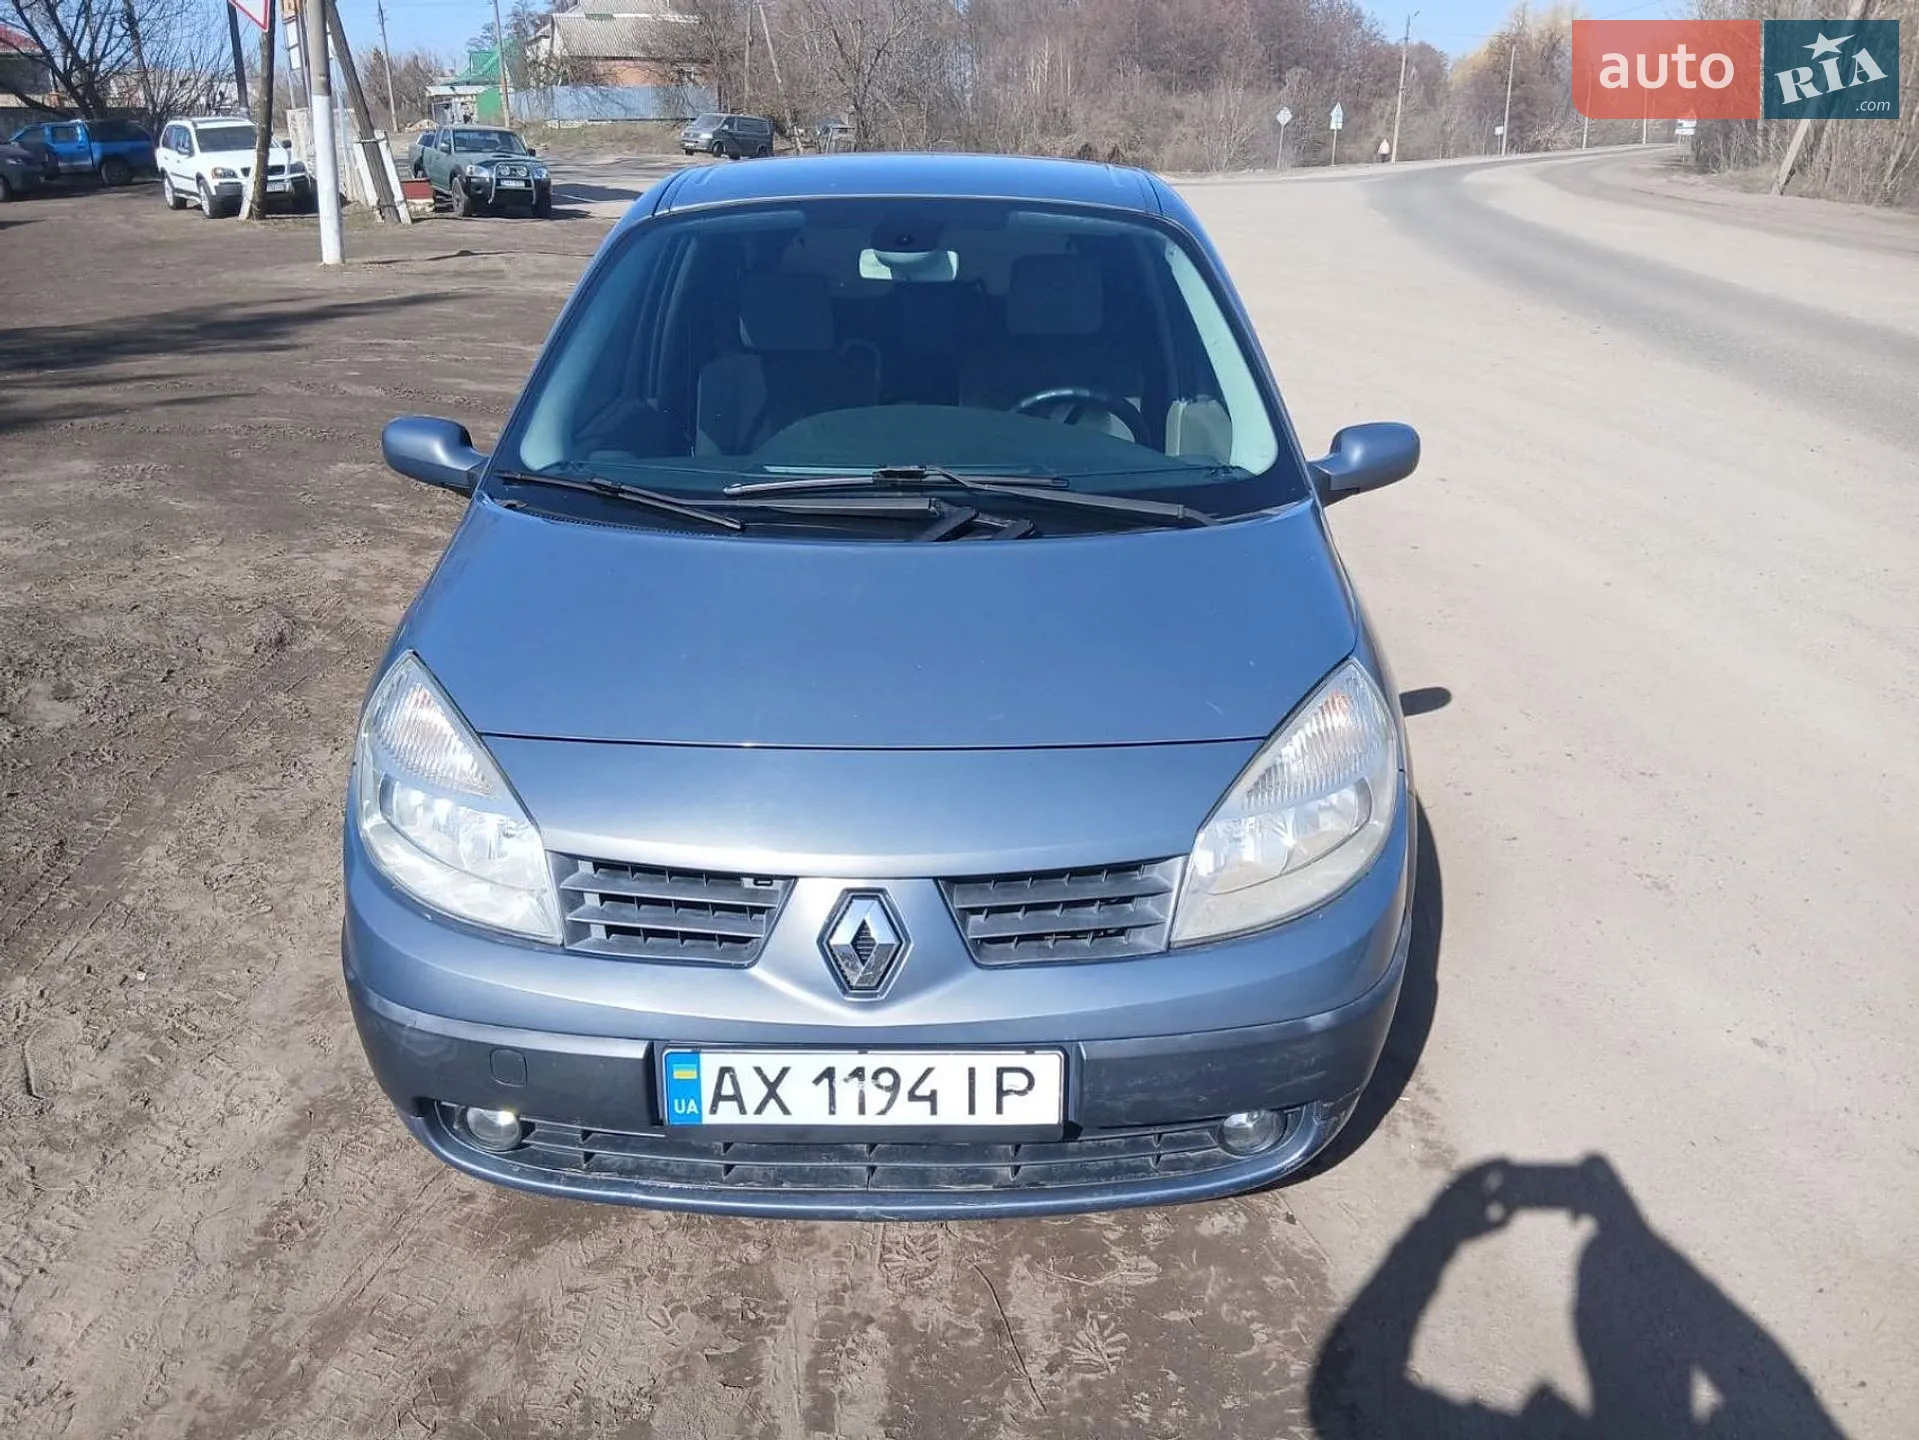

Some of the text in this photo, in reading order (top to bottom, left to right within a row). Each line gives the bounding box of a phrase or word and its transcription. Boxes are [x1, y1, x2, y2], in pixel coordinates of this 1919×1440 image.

[673, 1098, 699, 1115] UA
[708, 1065, 1036, 1116] AX 1194 IP
